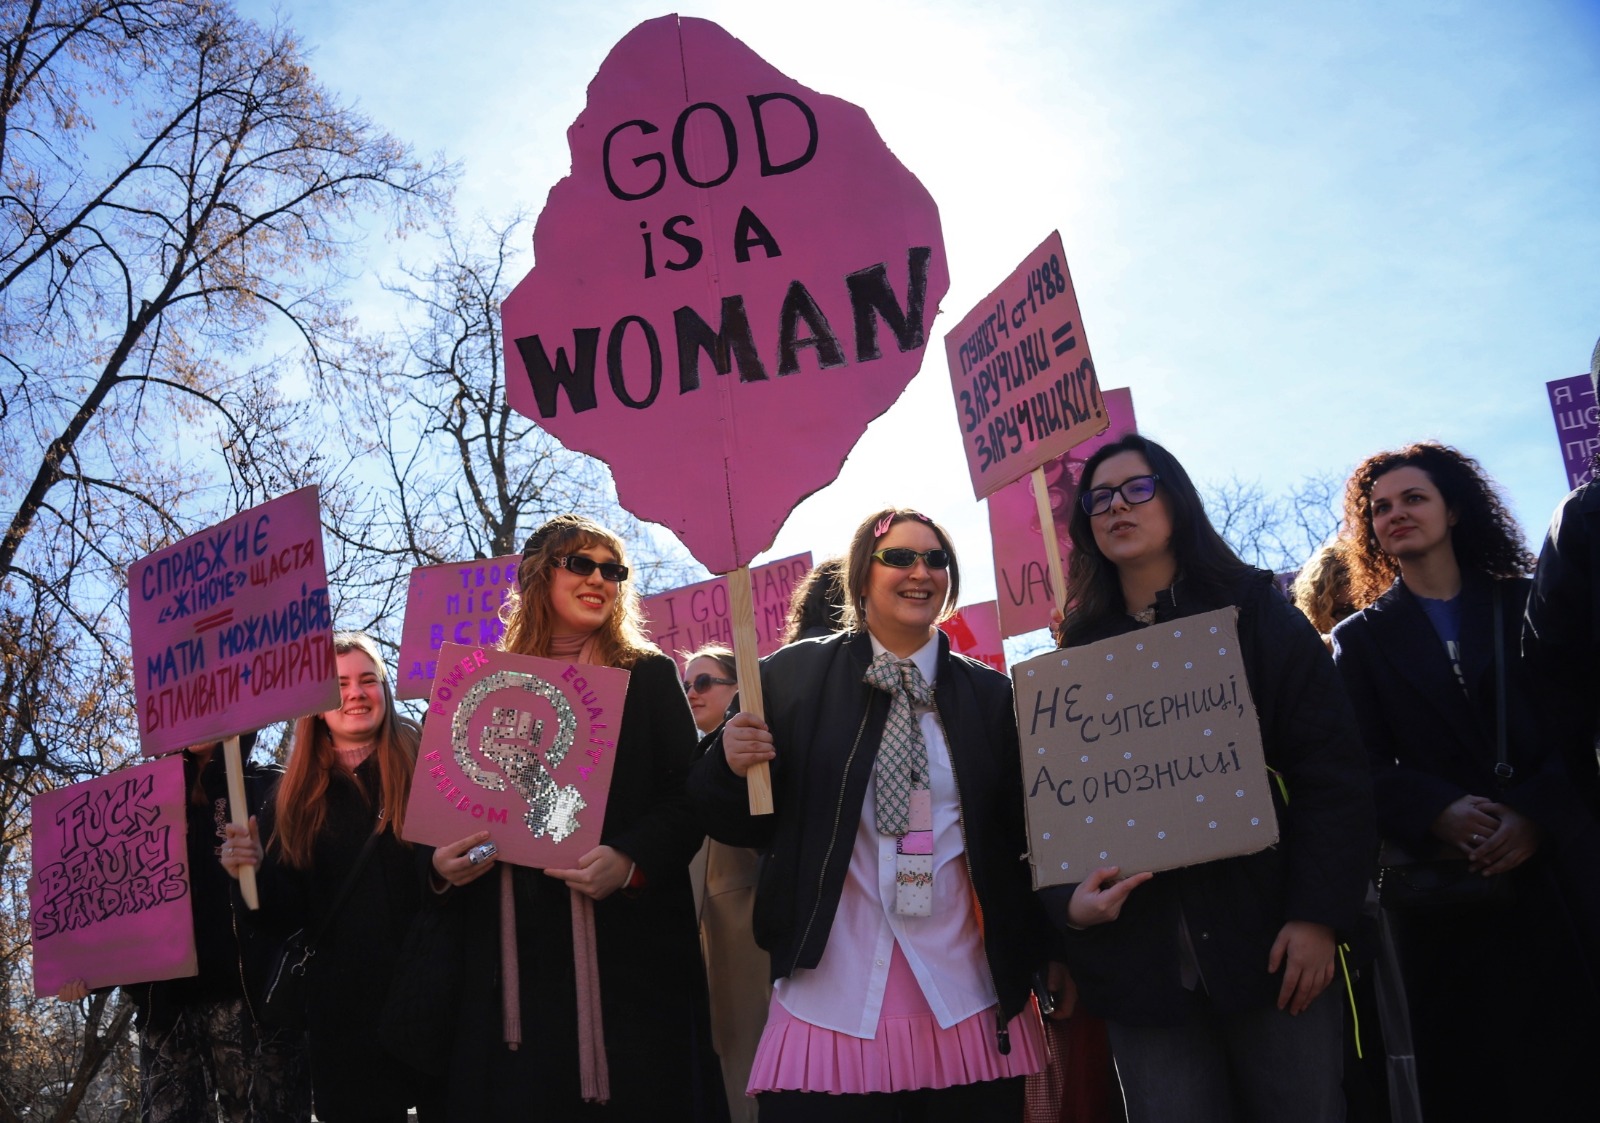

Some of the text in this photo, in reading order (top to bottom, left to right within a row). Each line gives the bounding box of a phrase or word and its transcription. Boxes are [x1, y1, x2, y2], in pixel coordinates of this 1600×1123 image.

[603, 92, 818, 201] GOD
[734, 205, 782, 263] A
[1027, 253, 1066, 314] 1488
[514, 246, 931, 418] WOMAN
[960, 321, 1076, 433] ЗАРУЧИНИ =
[1553, 385, 1573, 405] Я
[975, 357, 1102, 473] ЗАРУЧНИКИ?
[1566, 437, 1600, 461] ПР
[142, 514, 270, 601] СПРАВЖНЄ
[251, 539, 314, 588] ЩАСТЯ
[430, 617, 504, 650] ВСЮ
[665, 597, 678, 630] I
[691, 584, 727, 623] GO
[147, 637, 205, 690] МАТИ
[430, 649, 489, 716] POWER
[1030, 683, 1083, 736] НЕ
[424, 750, 508, 824] FREEDOM
[1029, 765, 1056, 797] А
[56, 774, 161, 859] FUCK
[38, 825, 171, 905] BEAUTY
[34, 862, 188, 940] STANDARTS
